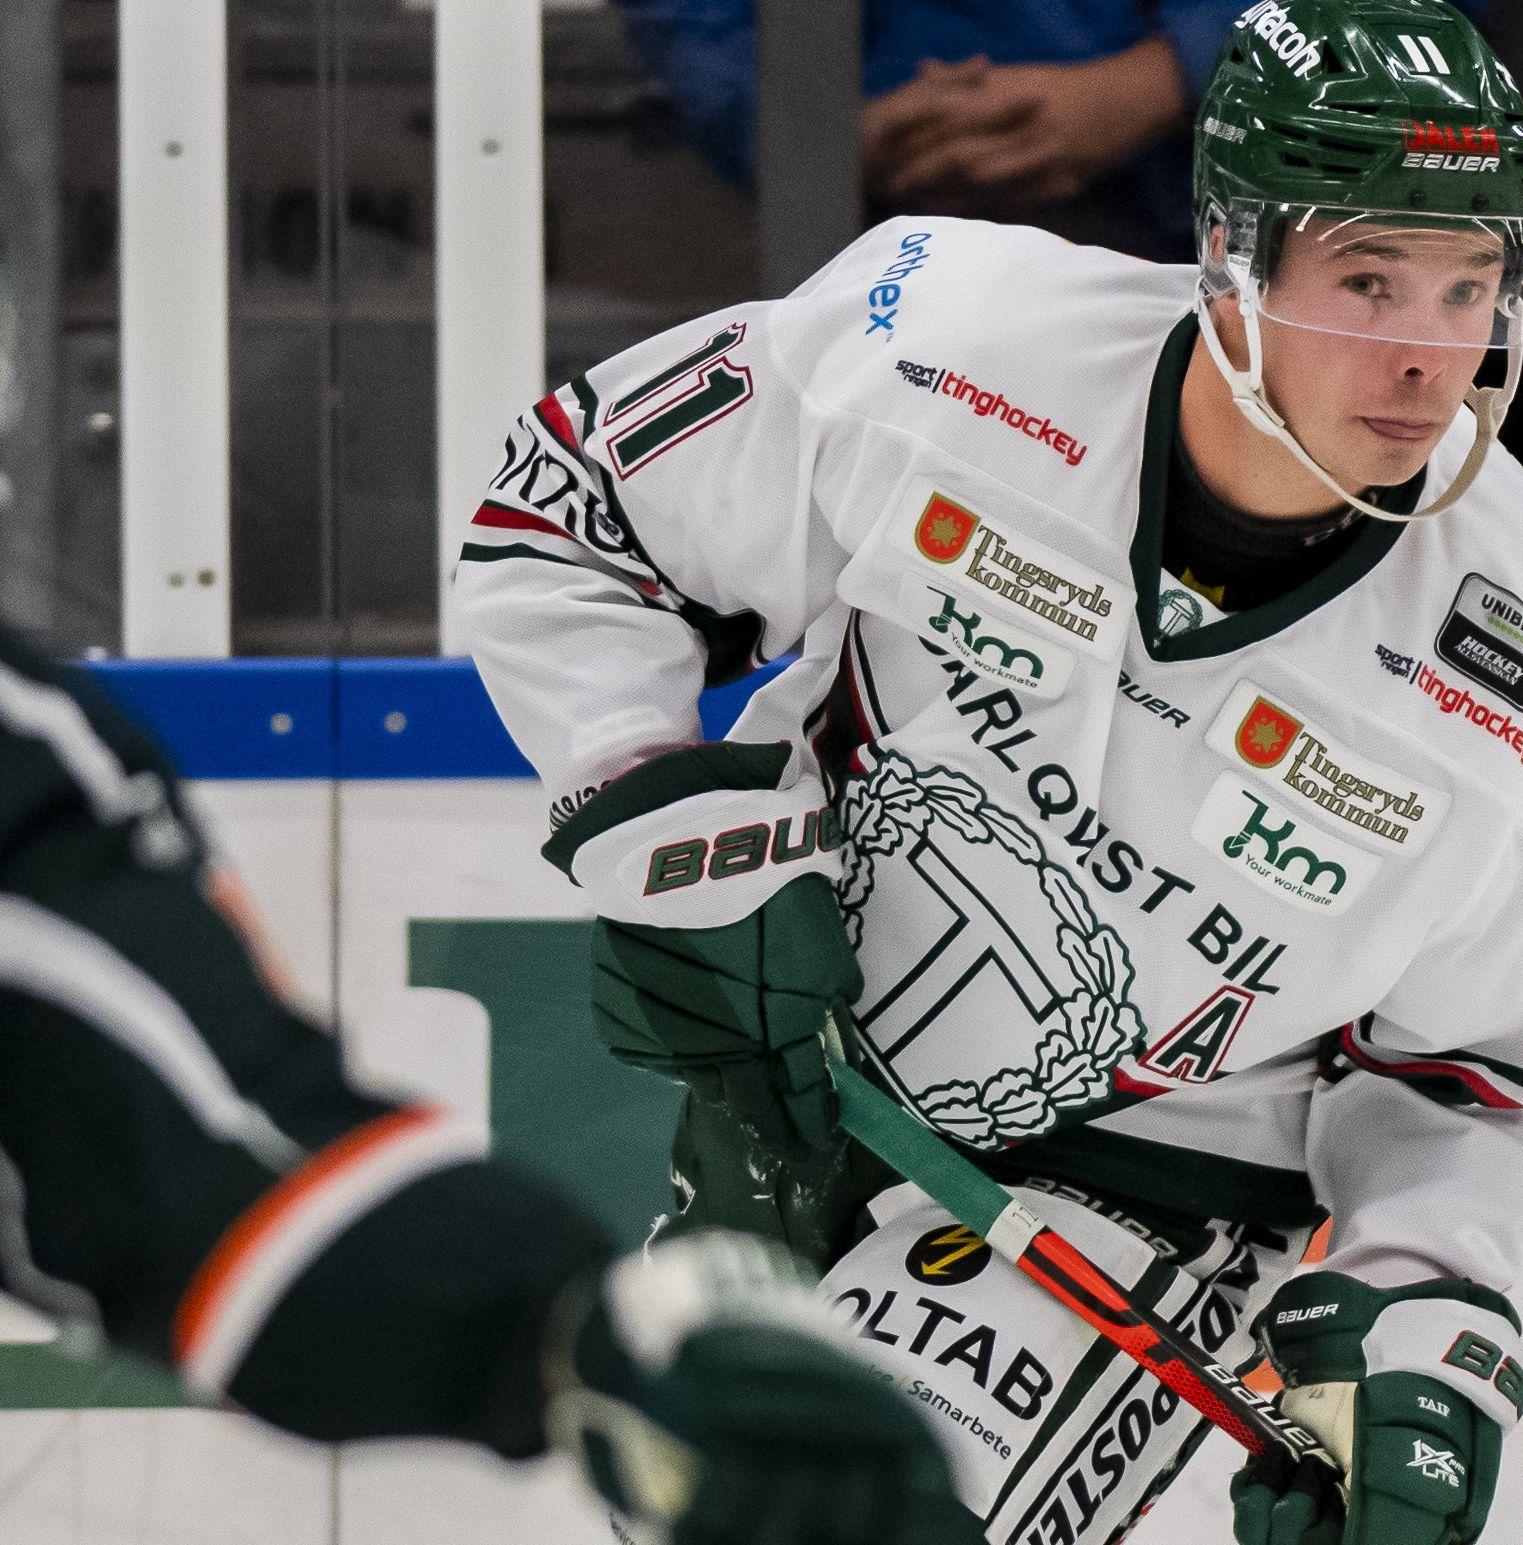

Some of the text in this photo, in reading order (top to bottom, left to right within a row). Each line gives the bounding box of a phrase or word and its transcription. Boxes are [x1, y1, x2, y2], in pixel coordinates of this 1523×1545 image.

[1397, 35, 1452, 75] 11
[1401, 152, 1501, 173] BAUER
[866, 232, 933, 335] orthex
[603, 321, 754, 482] 11
[942, 371, 1088, 467] tinghockey
[965, 551, 1099, 643] kommun
[978, 524, 1113, 618] Tingsryds
[1117, 669, 1192, 730] AUER
[1282, 754, 1410, 844] kommun
[1298, 731, 1426, 823] Tingsryds
[642, 804, 846, 898] BAUE
[1244, 853, 1333, 907] Your workmate
[1186, 902, 1289, 995] BIL
[1276, 1302, 1340, 1325] BAUER
[907, 1379, 1012, 1460] Samarbete
[1203, 1363, 1327, 1456] BAUE
